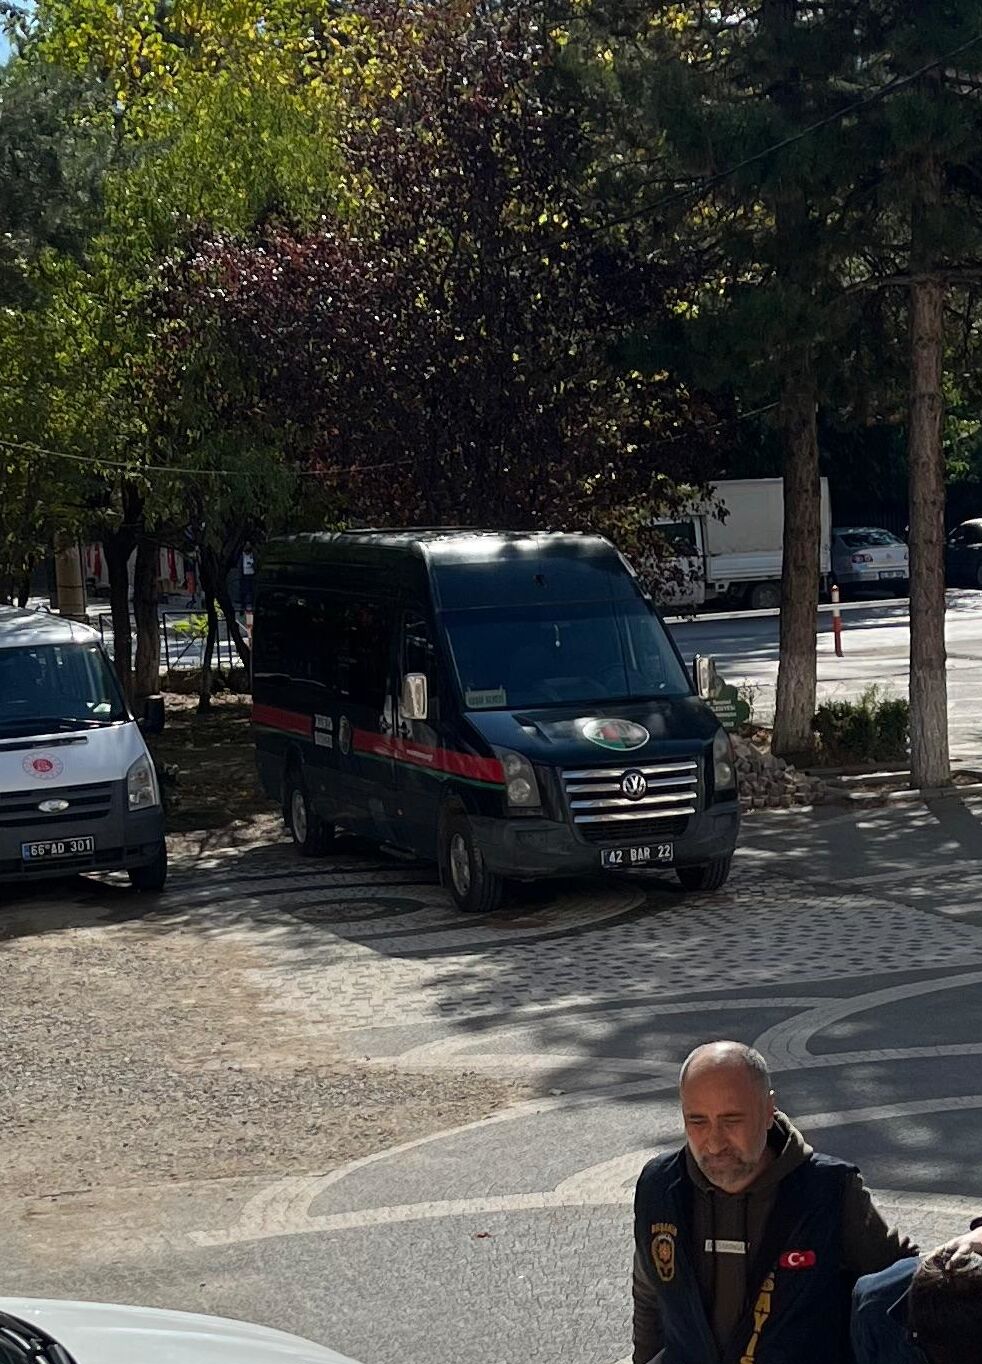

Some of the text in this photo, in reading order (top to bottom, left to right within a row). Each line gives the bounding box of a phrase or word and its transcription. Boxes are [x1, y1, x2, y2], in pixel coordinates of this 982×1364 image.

[31, 839, 90, 856] 66 AD 301
[609, 844, 671, 863] 42 BAR 22
